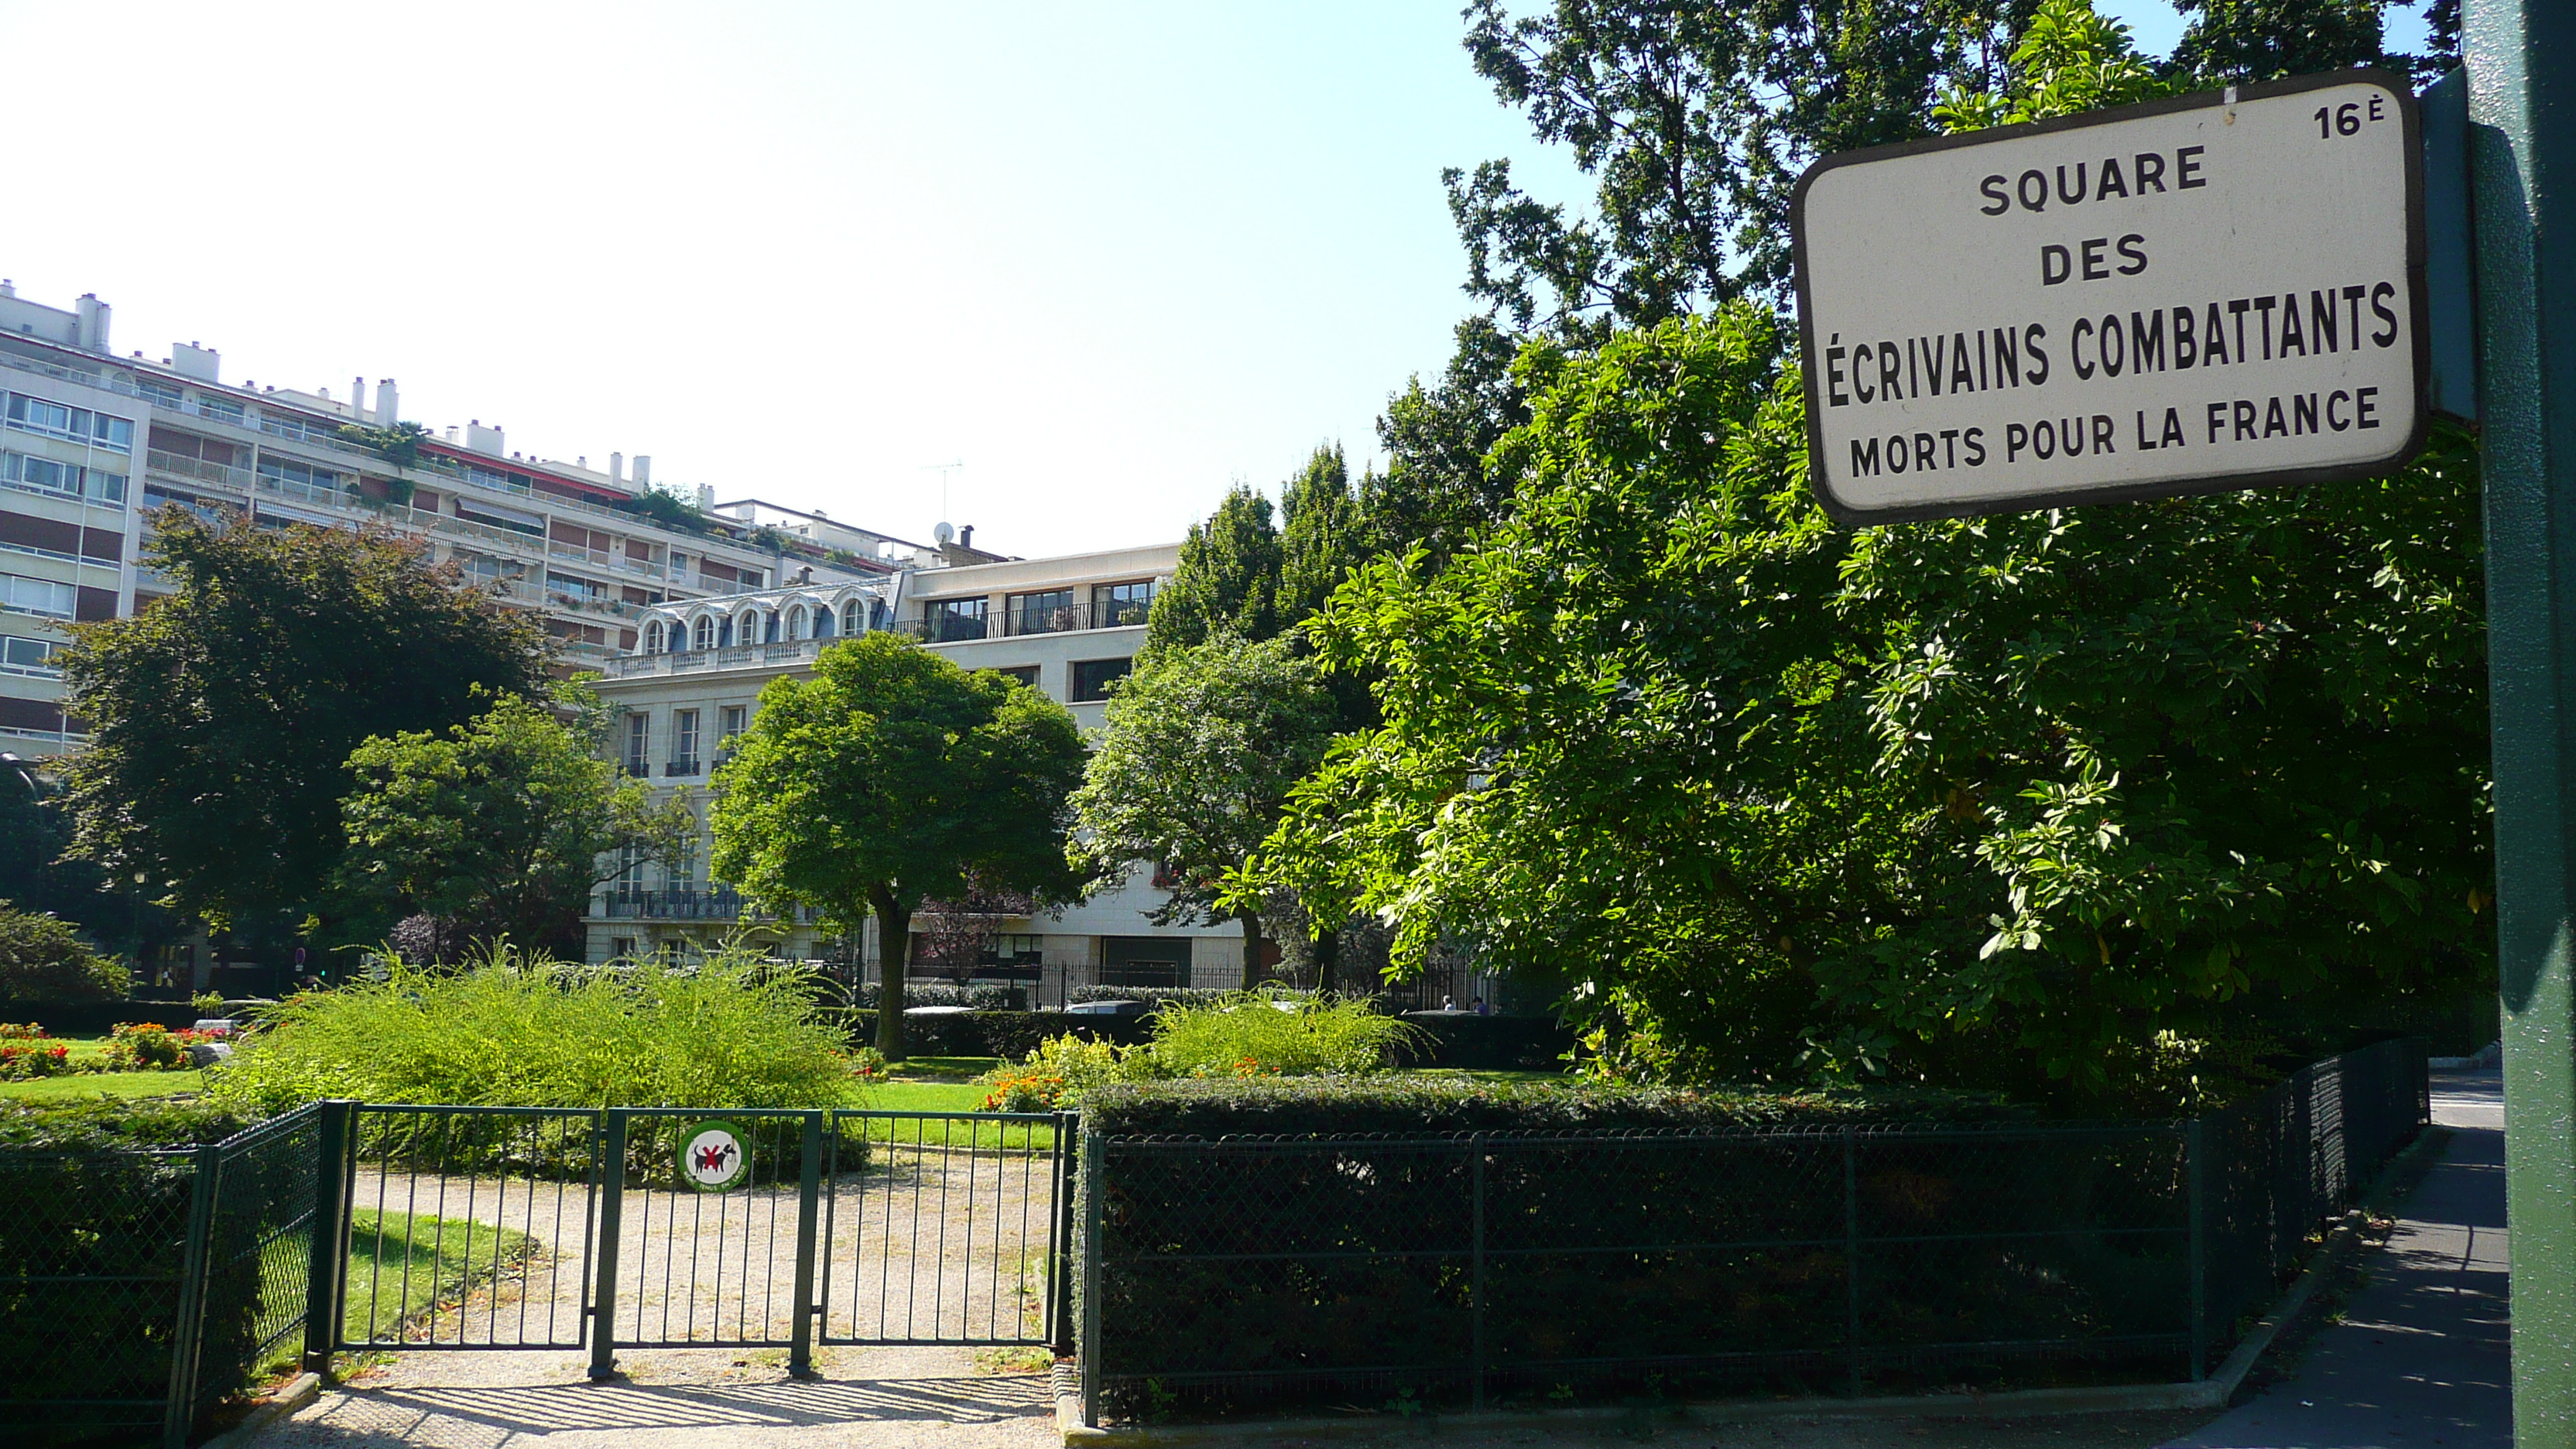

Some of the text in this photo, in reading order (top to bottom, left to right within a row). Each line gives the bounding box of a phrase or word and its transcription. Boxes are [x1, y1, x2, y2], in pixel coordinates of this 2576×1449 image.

[1980, 145, 2207, 217] SQUARE
[2040, 233, 2148, 286] DES
[1825, 281, 2398, 408] ÉCRIVAINS COMBATTANTS
[1850, 386, 2380, 478] MORTS POUR LA FRANCE
